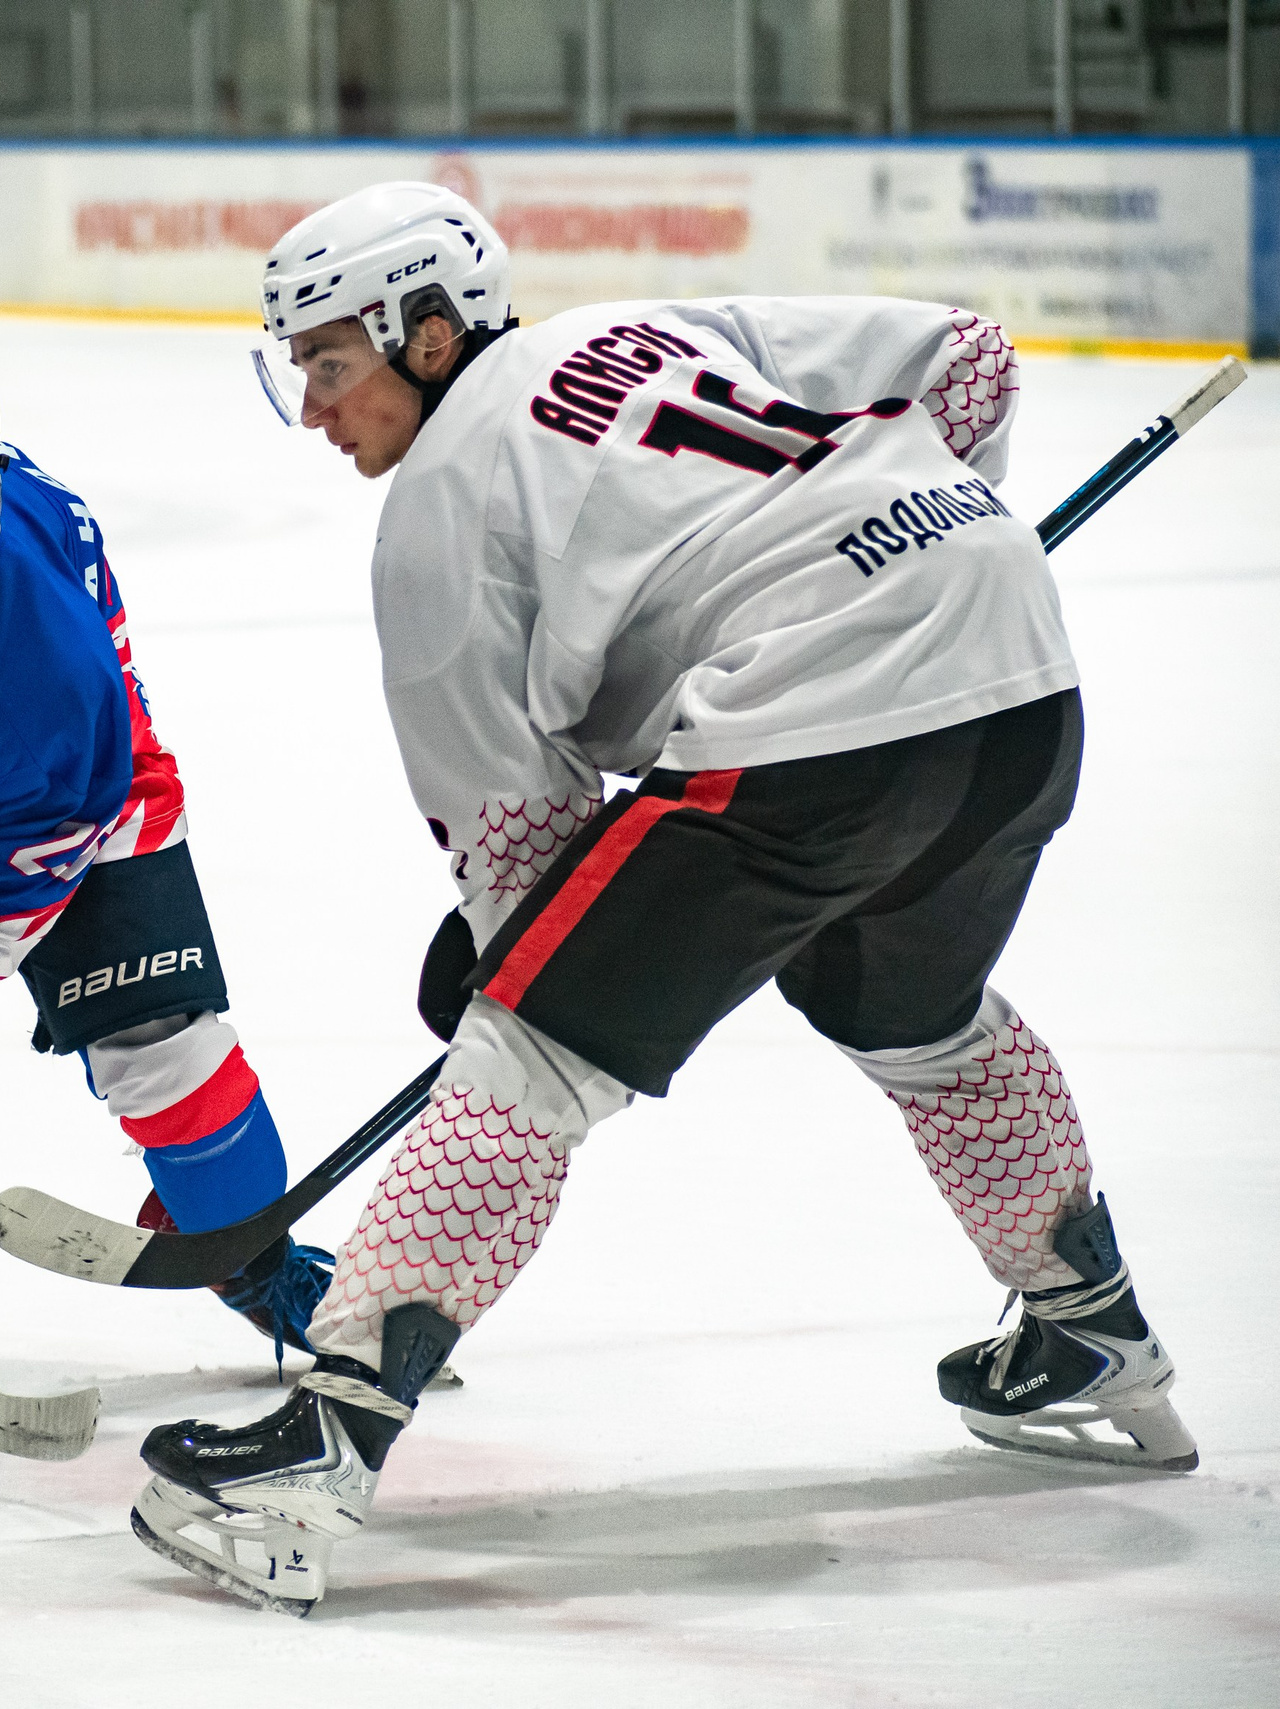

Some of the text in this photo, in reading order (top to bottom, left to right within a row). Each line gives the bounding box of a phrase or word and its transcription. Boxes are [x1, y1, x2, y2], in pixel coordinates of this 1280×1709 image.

[386, 254, 437, 284] CCM
[835, 478, 1012, 578] ПОДОЛЬСК
[57, 946, 206, 1009] BAUER
[1004, 1372, 1051, 1402] BAUER
[194, 1444, 264, 1459] BAUER
